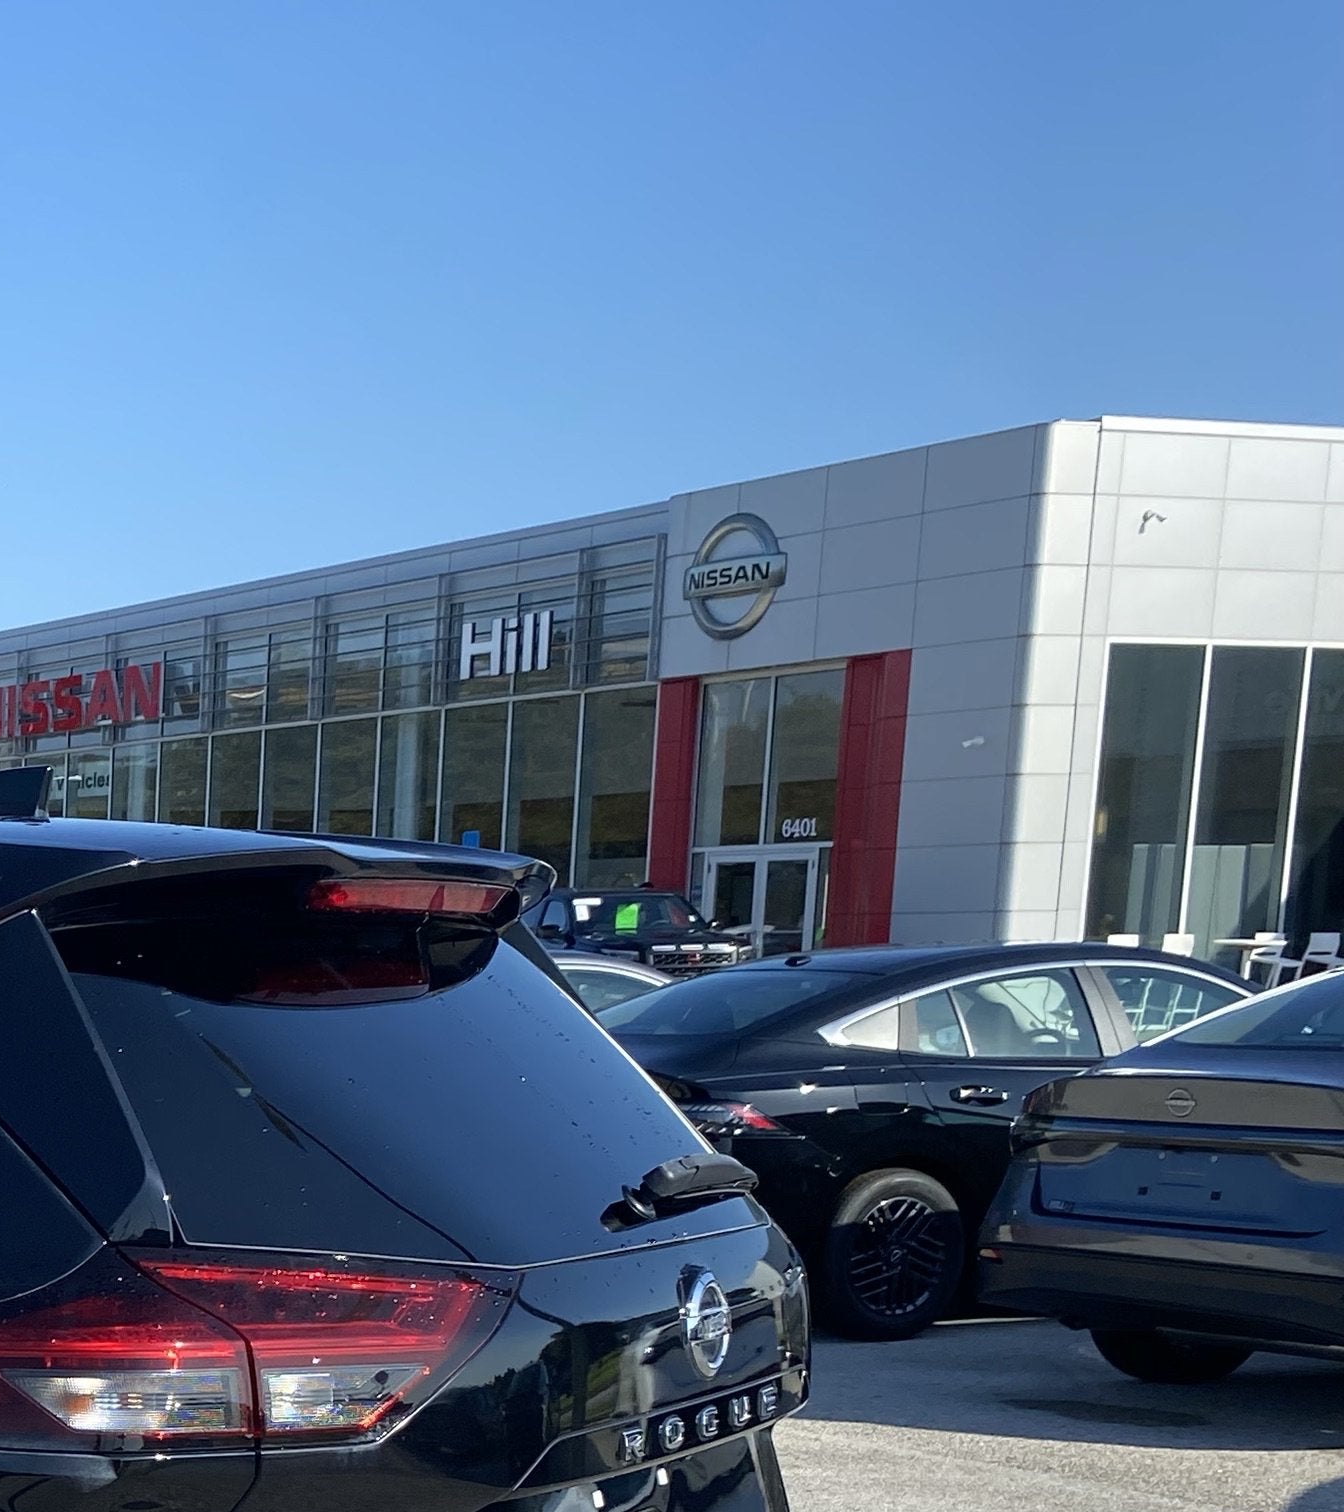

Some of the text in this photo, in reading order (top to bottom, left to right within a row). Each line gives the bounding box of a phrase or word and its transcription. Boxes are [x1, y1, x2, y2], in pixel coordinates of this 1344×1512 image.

[689, 561, 770, 590] NISSAN
[459, 609, 554, 680] Hill
[782, 817, 817, 838] 6401
[620, 1384, 778, 1464] ROGUE
